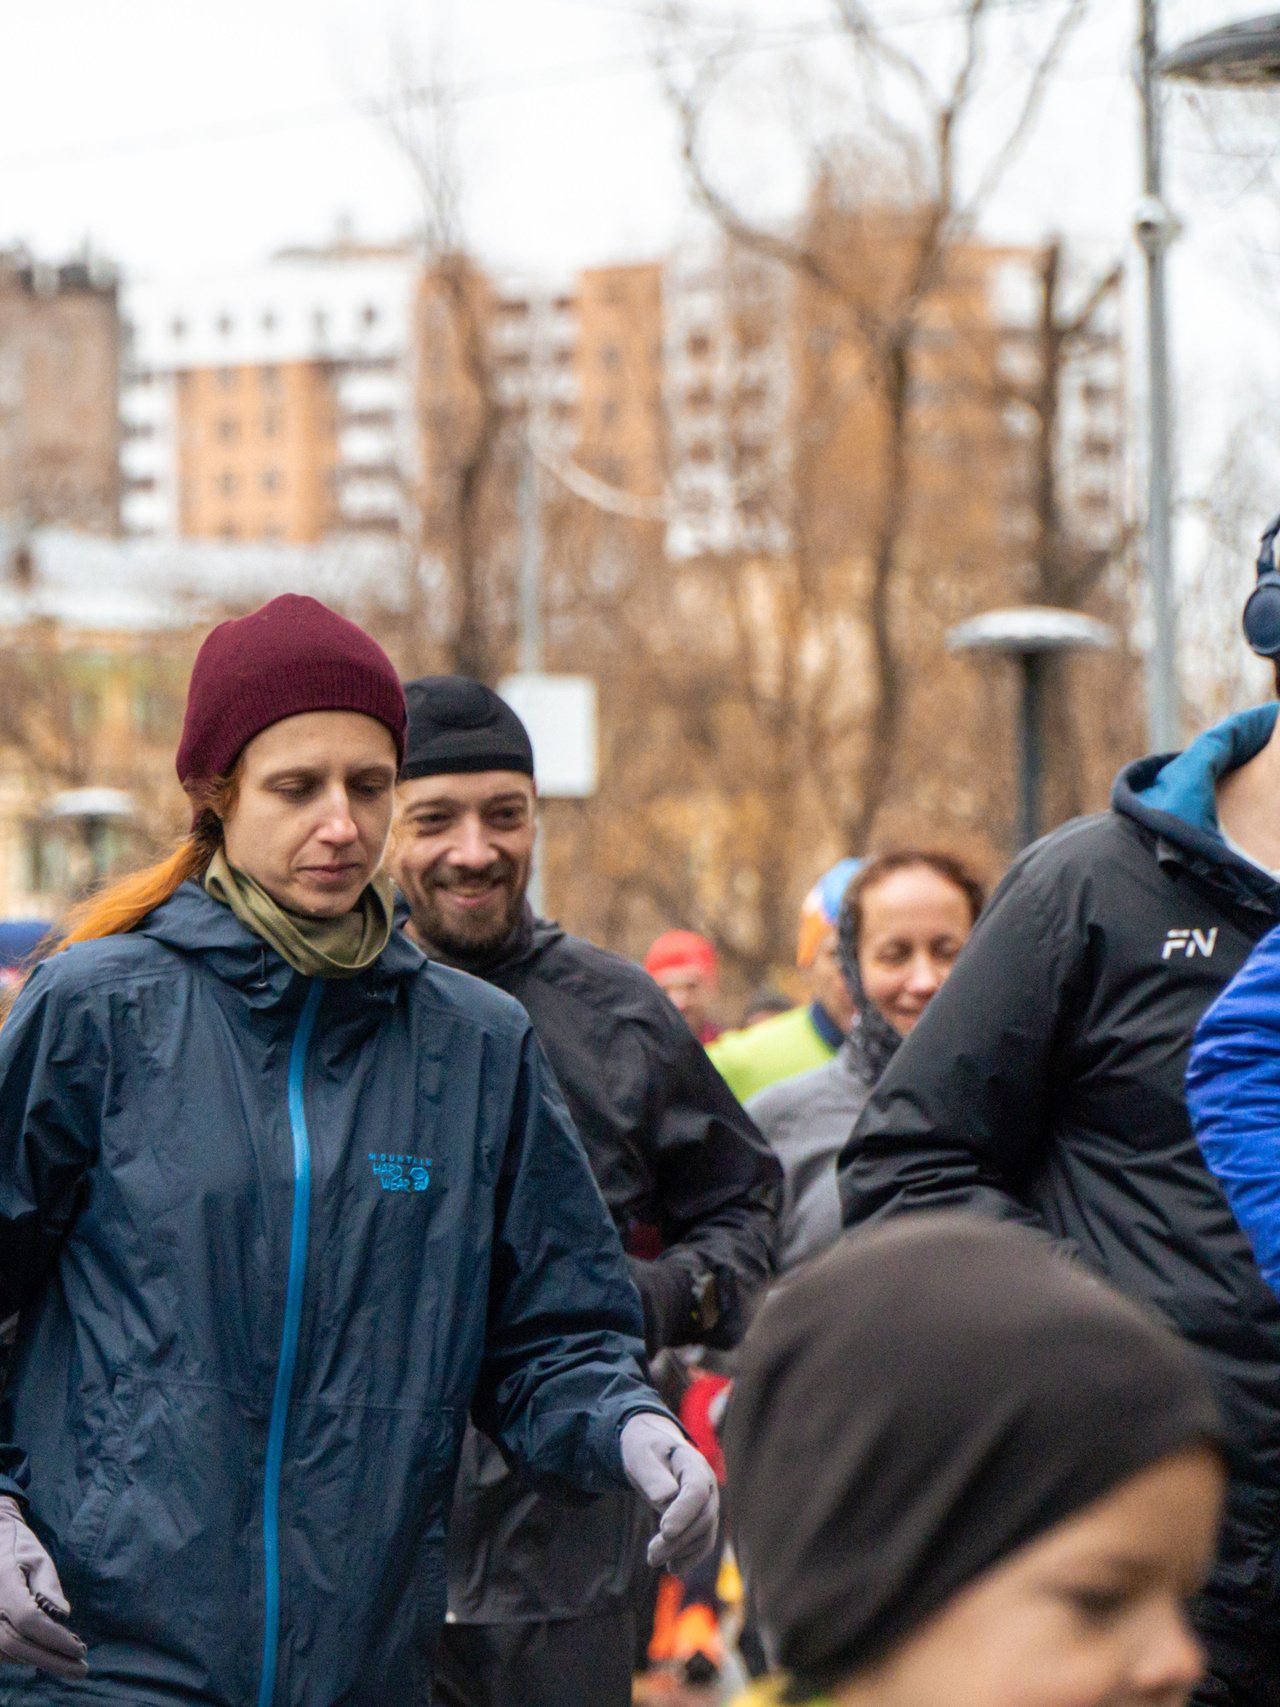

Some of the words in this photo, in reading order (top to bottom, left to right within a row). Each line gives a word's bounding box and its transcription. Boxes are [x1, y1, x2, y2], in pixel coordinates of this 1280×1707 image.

[1161, 926, 1219, 960] FN
[367, 1152, 433, 1167] MOUNTAIN
[372, 1163, 403, 1180] HARD
[380, 1176, 411, 1193] WEAR
